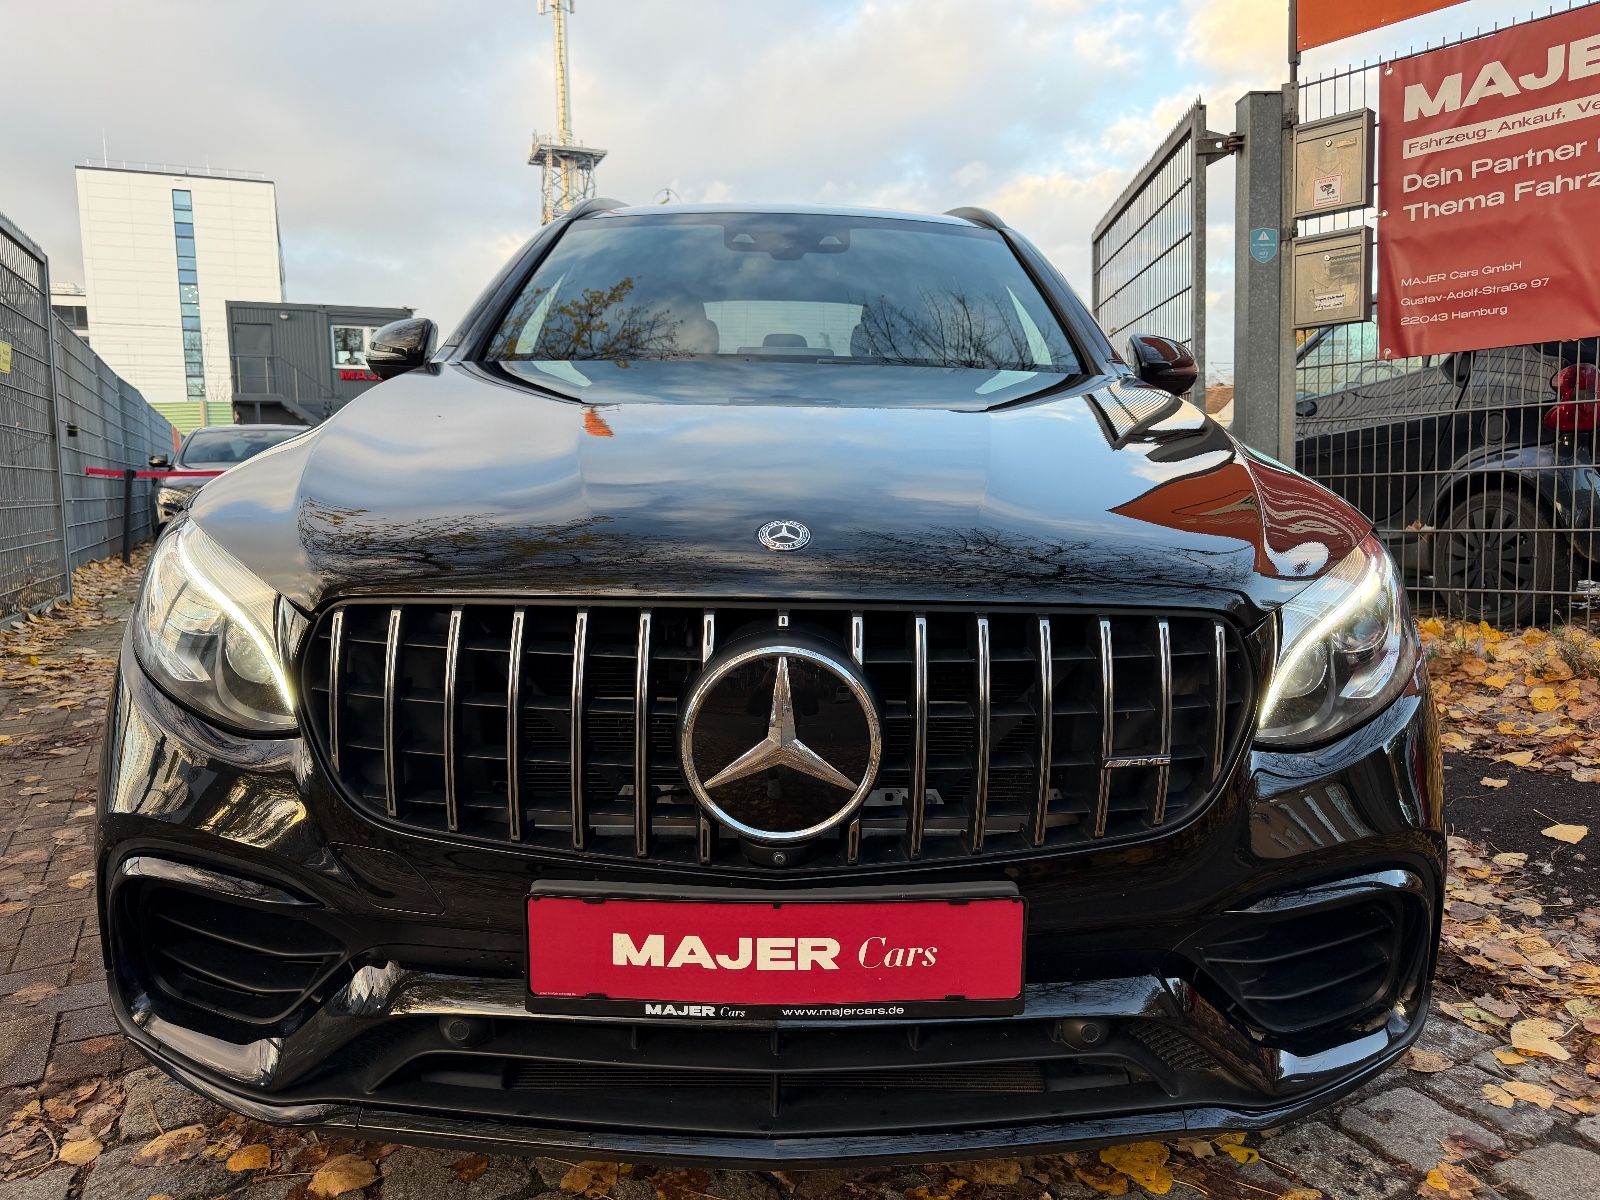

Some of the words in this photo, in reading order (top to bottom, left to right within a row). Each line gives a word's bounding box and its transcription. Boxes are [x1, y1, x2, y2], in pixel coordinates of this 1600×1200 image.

[1408, 128, 1493, 154] Fahrzeug-
[1498, 107, 1566, 133] Ankauf,
[1403, 167, 1463, 193] Dein
[1471, 140, 1588, 179] Partner
[1403, 191, 1505, 222] Thema
[1401, 273, 1446, 287] MAJER
[1449, 269, 1479, 280] Cars
[1481, 260, 1522, 275] GmbH
[1400, 282, 1528, 306] Gustav-Adolf-Straße
[1530, 277, 1550, 288] 97
[1400, 312, 1449, 326] 22043
[1451, 306, 1508, 320] Hamburg
[612, 932, 841, 971] MAJER
[858, 936, 938, 969] Cars
[645, 1004, 716, 1017] MAJER
[720, 1006, 746, 1018] Cars
[782, 1006, 905, 1017] www.majercars.de
